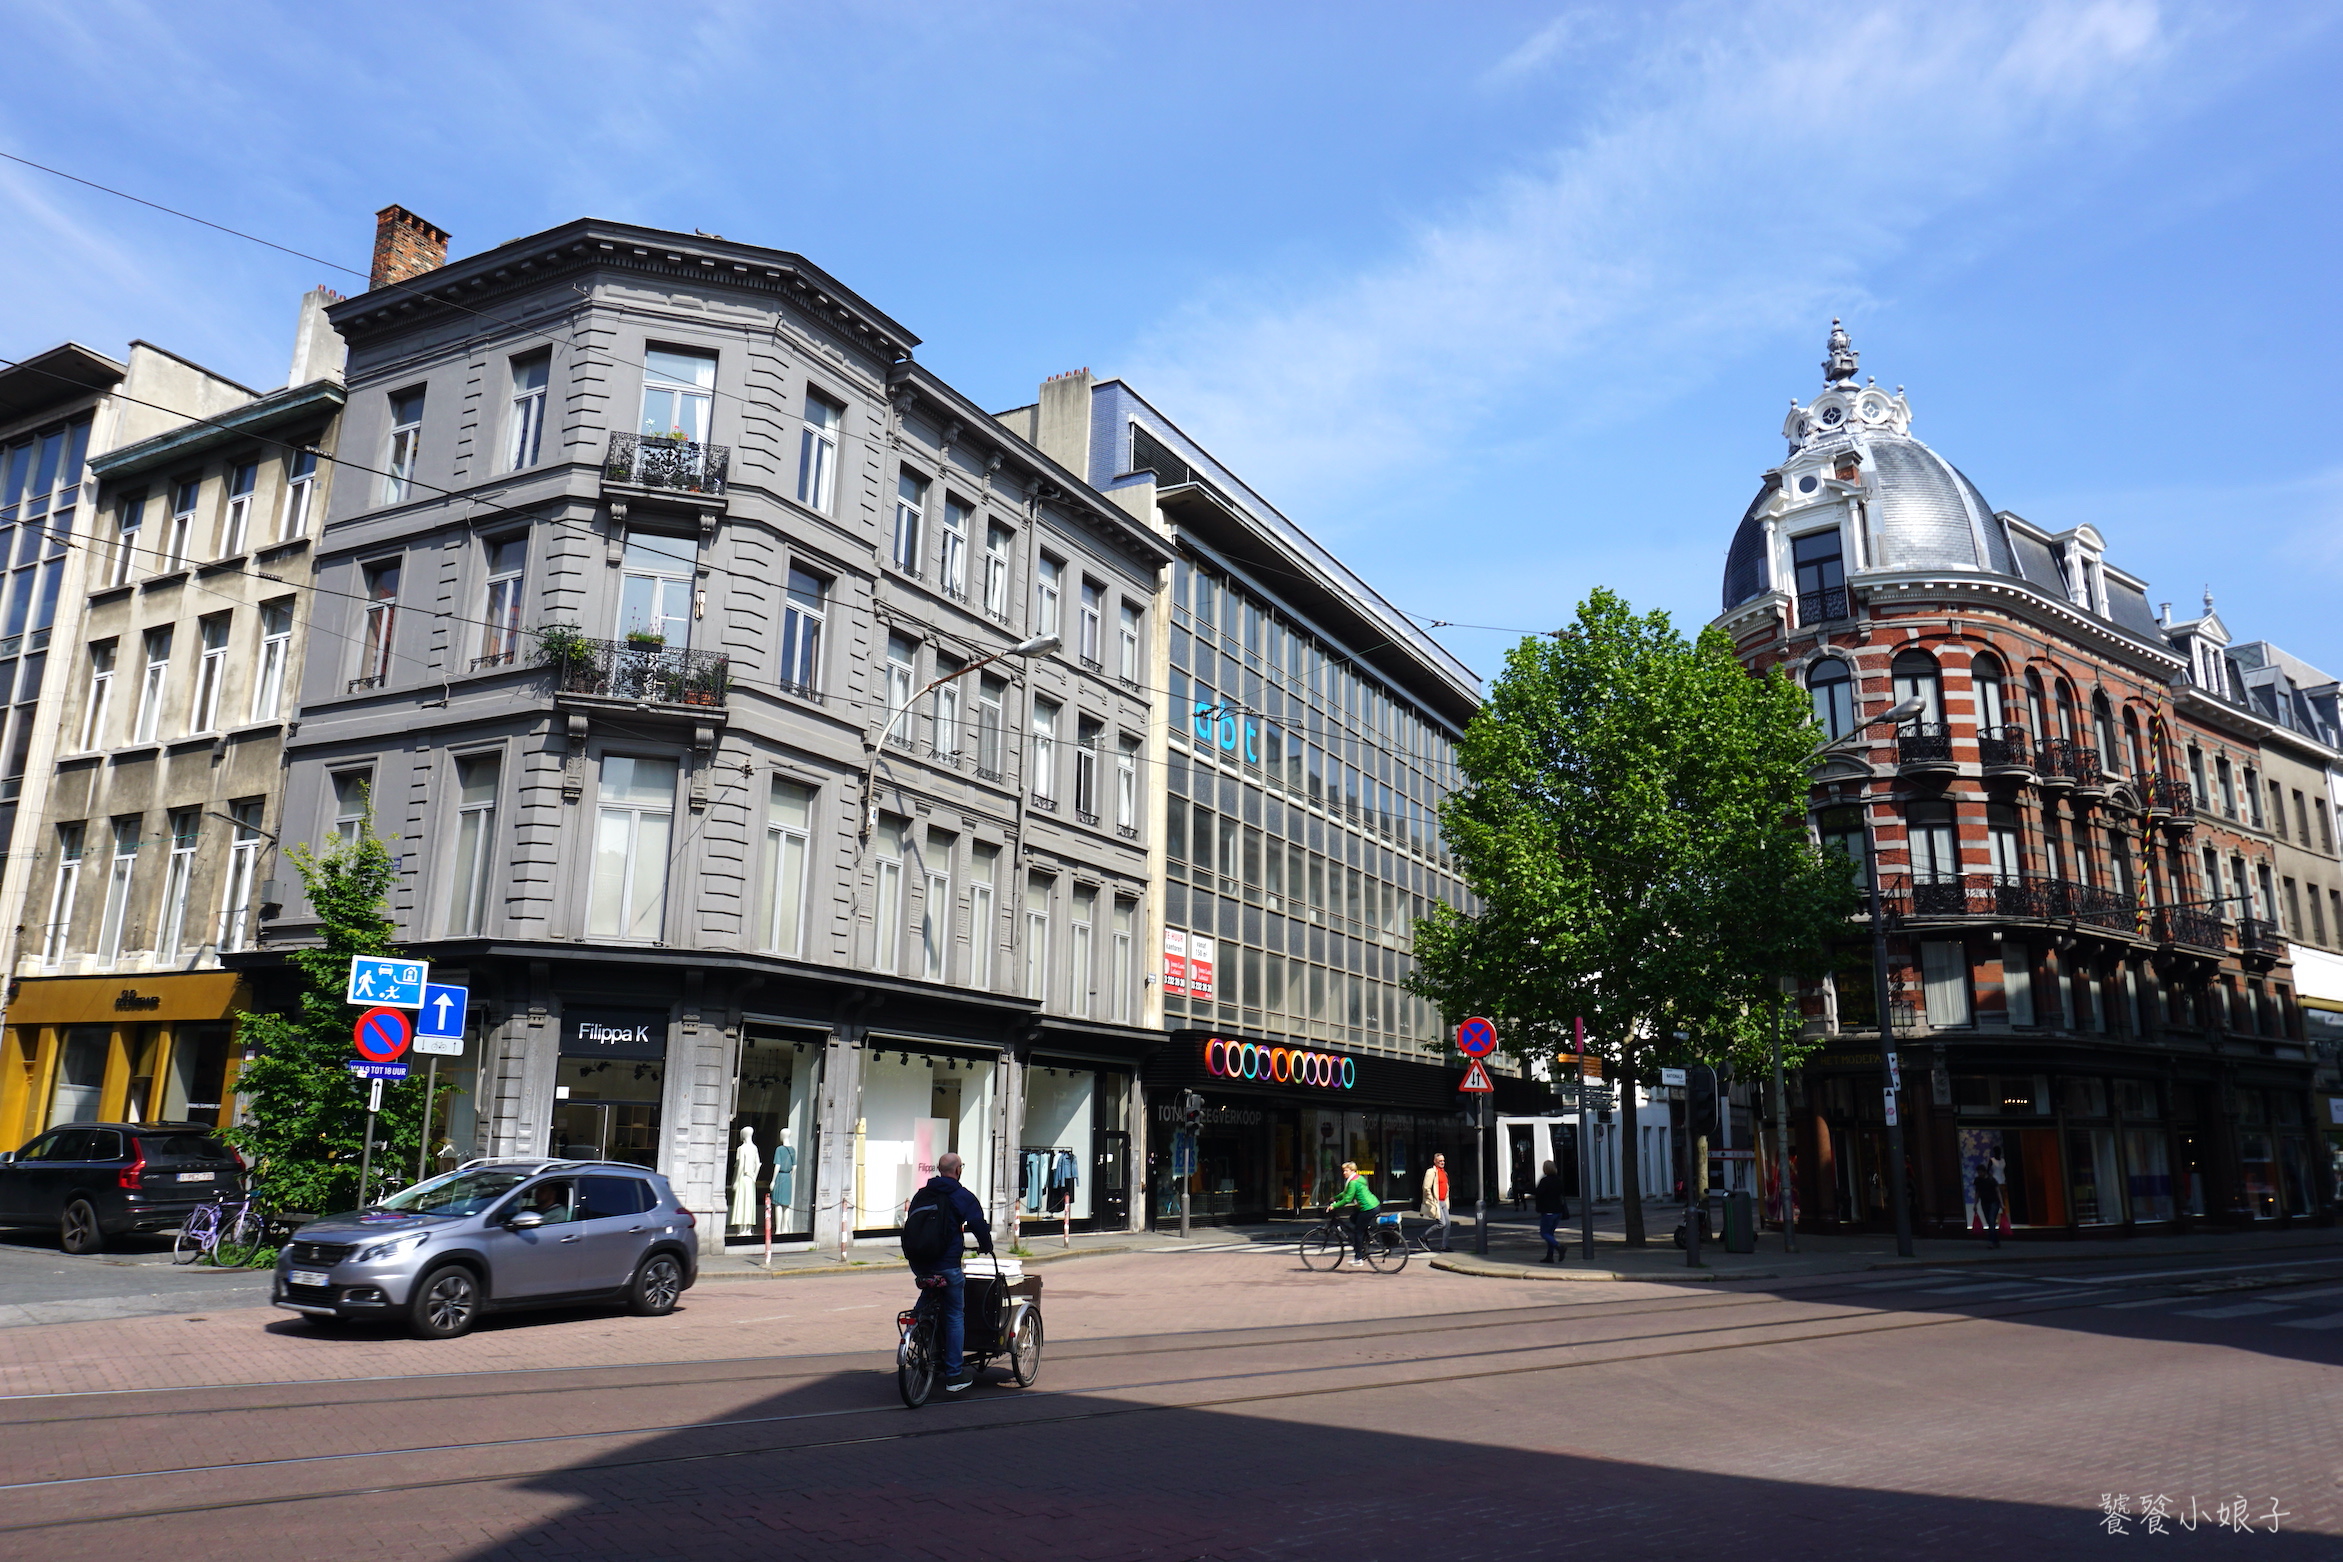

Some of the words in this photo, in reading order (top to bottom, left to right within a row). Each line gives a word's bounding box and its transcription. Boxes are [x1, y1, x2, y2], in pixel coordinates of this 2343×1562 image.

[1195, 700, 1257, 763] abt
[579, 1022, 632, 1044] Filippa
[636, 1025, 649, 1042] K
[371, 1066, 384, 1074] TOT
[385, 1067, 391, 1075] 18
[392, 1067, 407, 1075] UUR
[1202, 1107, 1262, 1126] EEGVERKOOP
